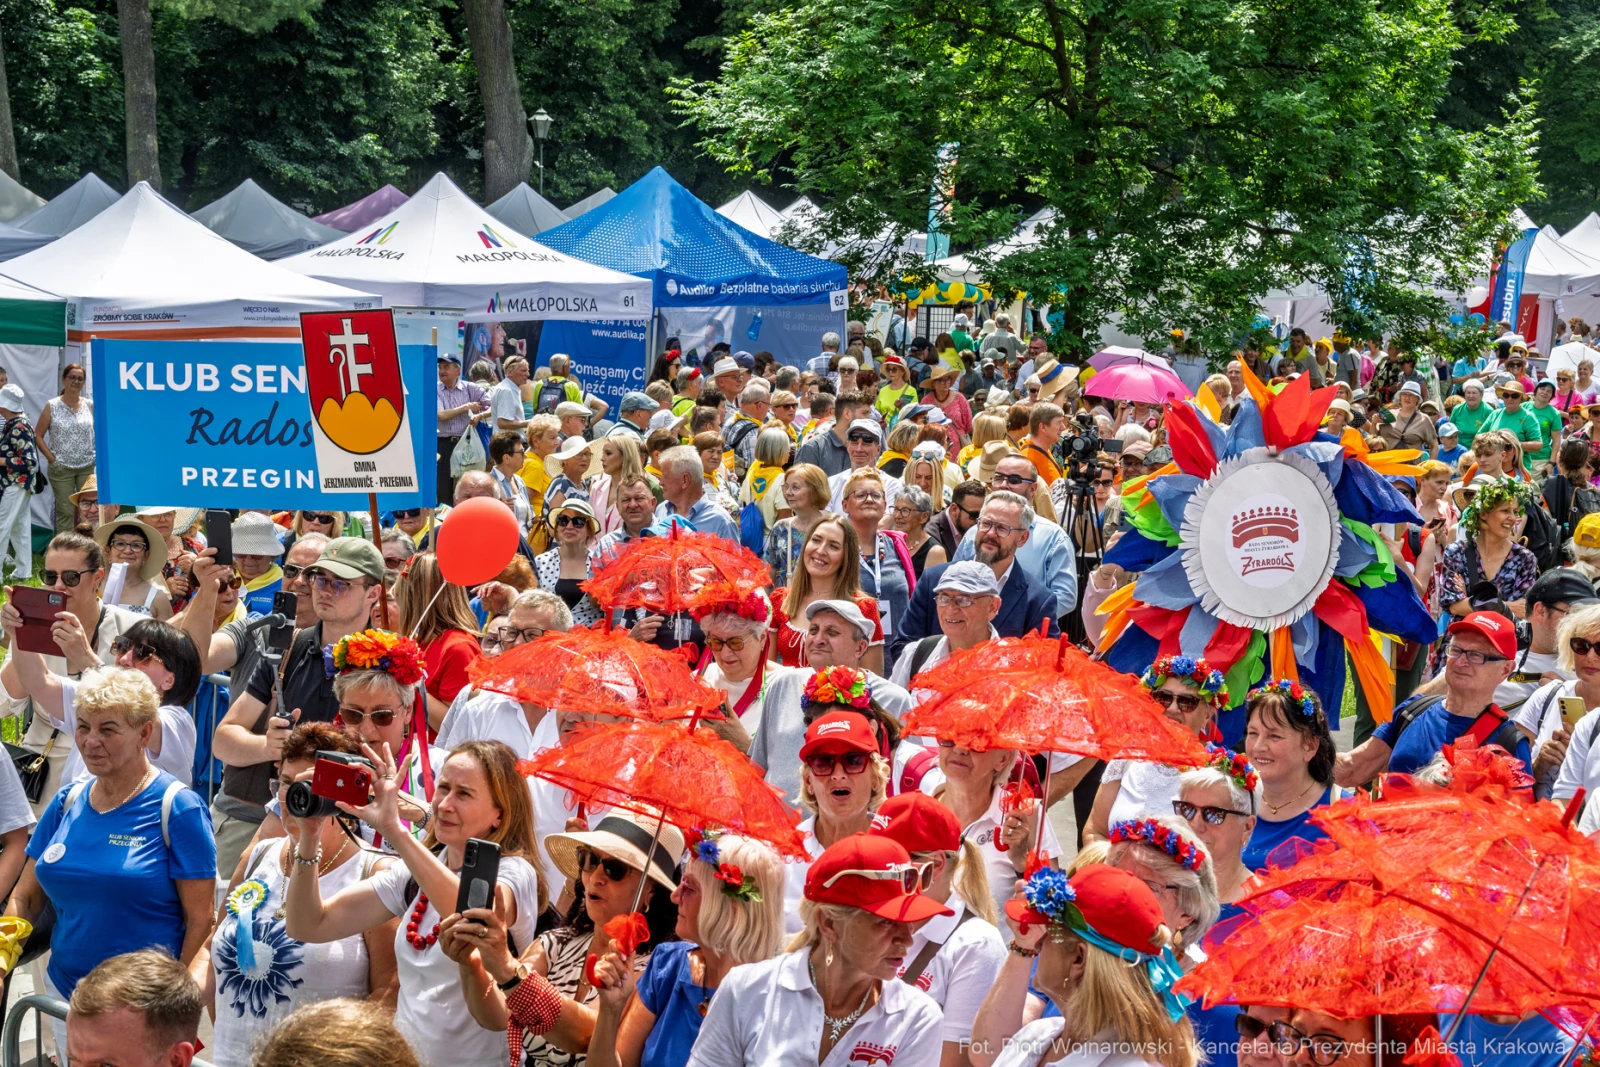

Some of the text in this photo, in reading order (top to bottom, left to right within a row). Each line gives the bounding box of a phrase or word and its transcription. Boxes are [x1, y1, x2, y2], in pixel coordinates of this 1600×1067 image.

[310, 247, 405, 260] MAŁOPOLSKA
[456, 251, 565, 263] MAŁOPOLSKA
[720, 281, 769, 296] Bezpłatne
[770, 281, 809, 295] badania
[810, 280, 841, 292] słuchu
[507, 297, 598, 312] MAŁOPOLSKA
[623, 295, 635, 307] 61
[834, 295, 844, 307] 62
[123, 313, 142, 321] SOBIE
[144, 312, 174, 320] KRAKÓW
[119, 361, 219, 393] KLUB
[569, 360, 630, 382] Pomagamy
[185, 400, 313, 448] Rados
[353, 461, 377, 472] GMINA
[181, 466, 315, 489] PRZEGIN
[379, 476, 413, 488] PRZEGINIA
